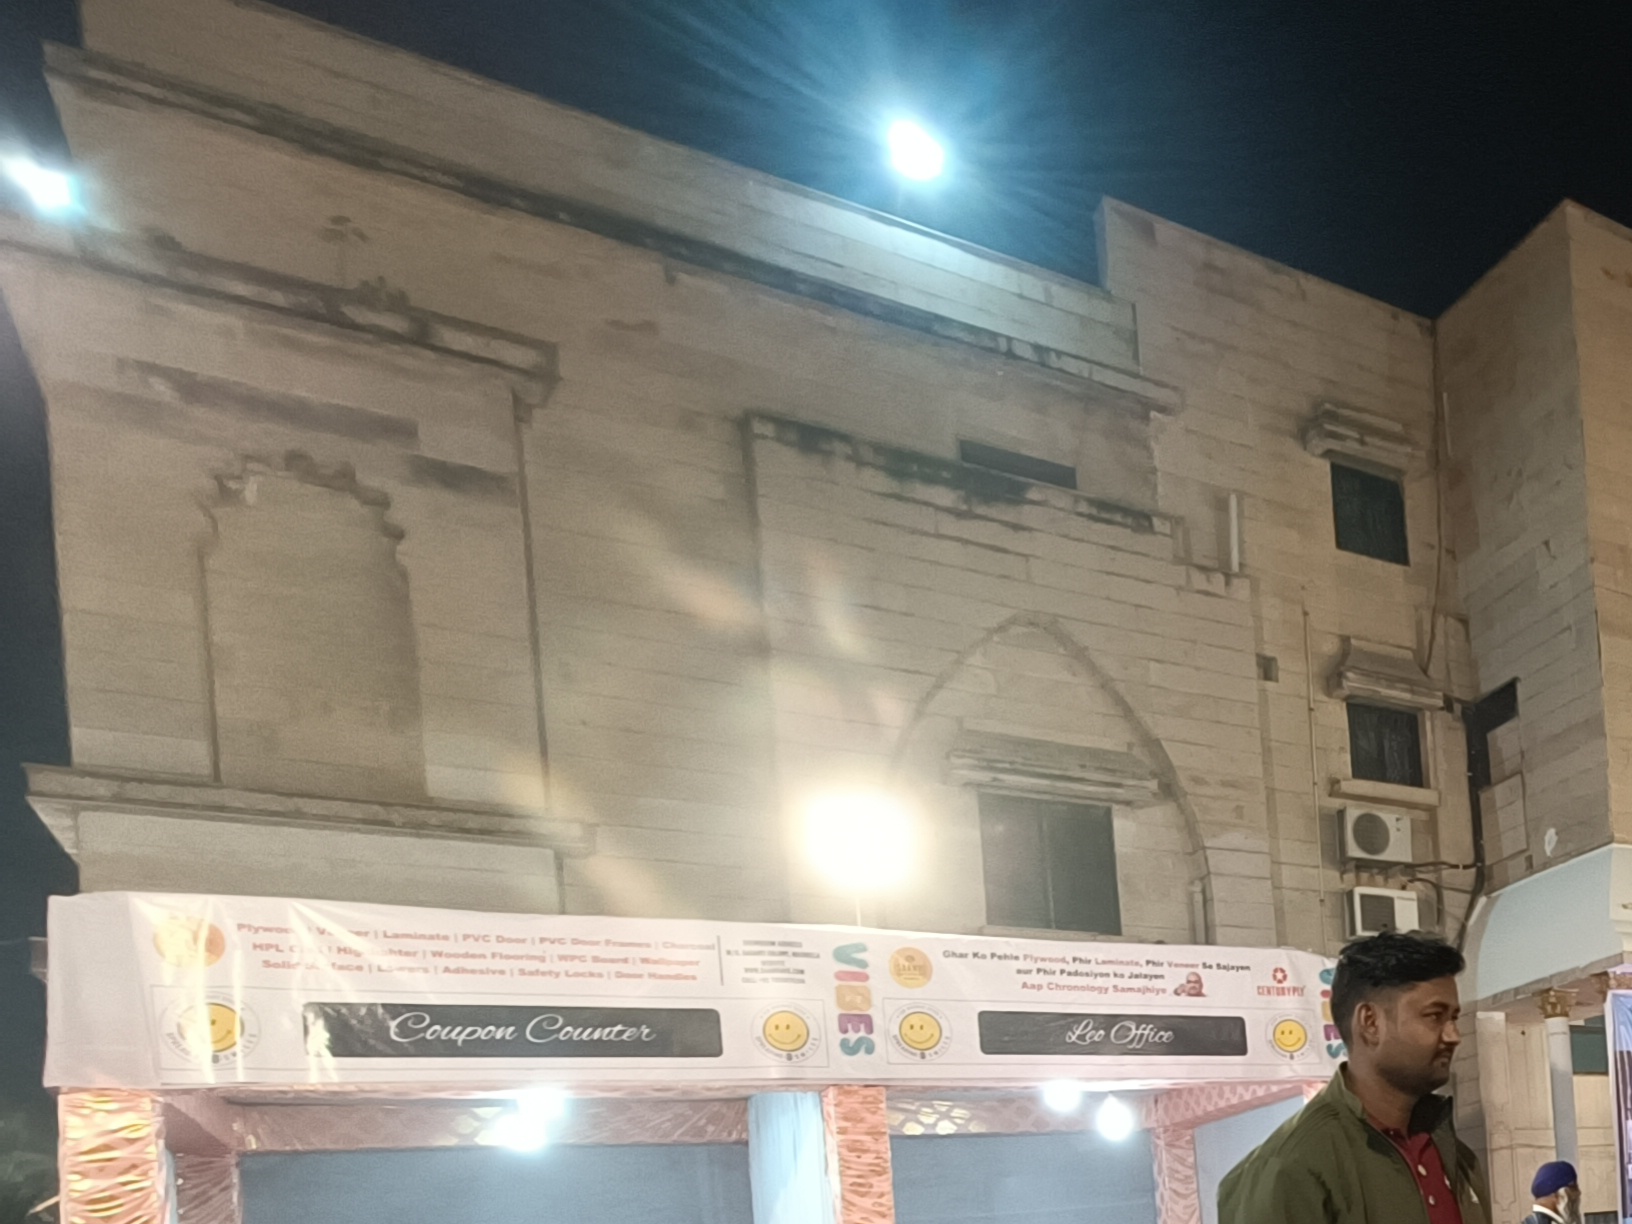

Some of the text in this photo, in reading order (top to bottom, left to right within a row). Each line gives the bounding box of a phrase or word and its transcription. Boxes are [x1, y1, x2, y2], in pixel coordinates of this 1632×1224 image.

[383, 930, 450, 942] Laminate
[462, 934, 491, 943] PVC
[496, 935, 528, 945] Door
[539, 937, 567, 946] PVC
[571, 938, 601, 947] Door
[252, 942, 284, 953] HPL
[431, 949, 487, 960] Wooden
[491, 951, 546, 963] Flooring
[591, 954, 629, 964] Board
[943, 950, 968, 959] Ghar
[972, 951, 987, 960] Ko
[990, 952, 1020, 962] Pehle
[1072, 957, 1092, 965] Phir
[1145, 960, 1164, 968] Phir
[1167, 961, 1199, 969] Veneer
[1202, 962, 1213, 970] Se
[1216, 963, 1251, 973] Sajayen
[443, 965, 506, 976] Adhesive
[518, 968, 560, 979] Safety
[565, 969, 604, 979] Locks
[1036, 967, 1056, 976] Phir
[1060, 968, 1110, 979] Padosiyon
[1113, 970, 1125, 978] ko
[833, 942, 875, 1057] VIBES
[1021, 981, 1167, 996] Aap Chronology Samajhiye
[389, 1011, 657, 1047] Coupon Counter
[1065, 1018, 1175, 1049] Leo Office
